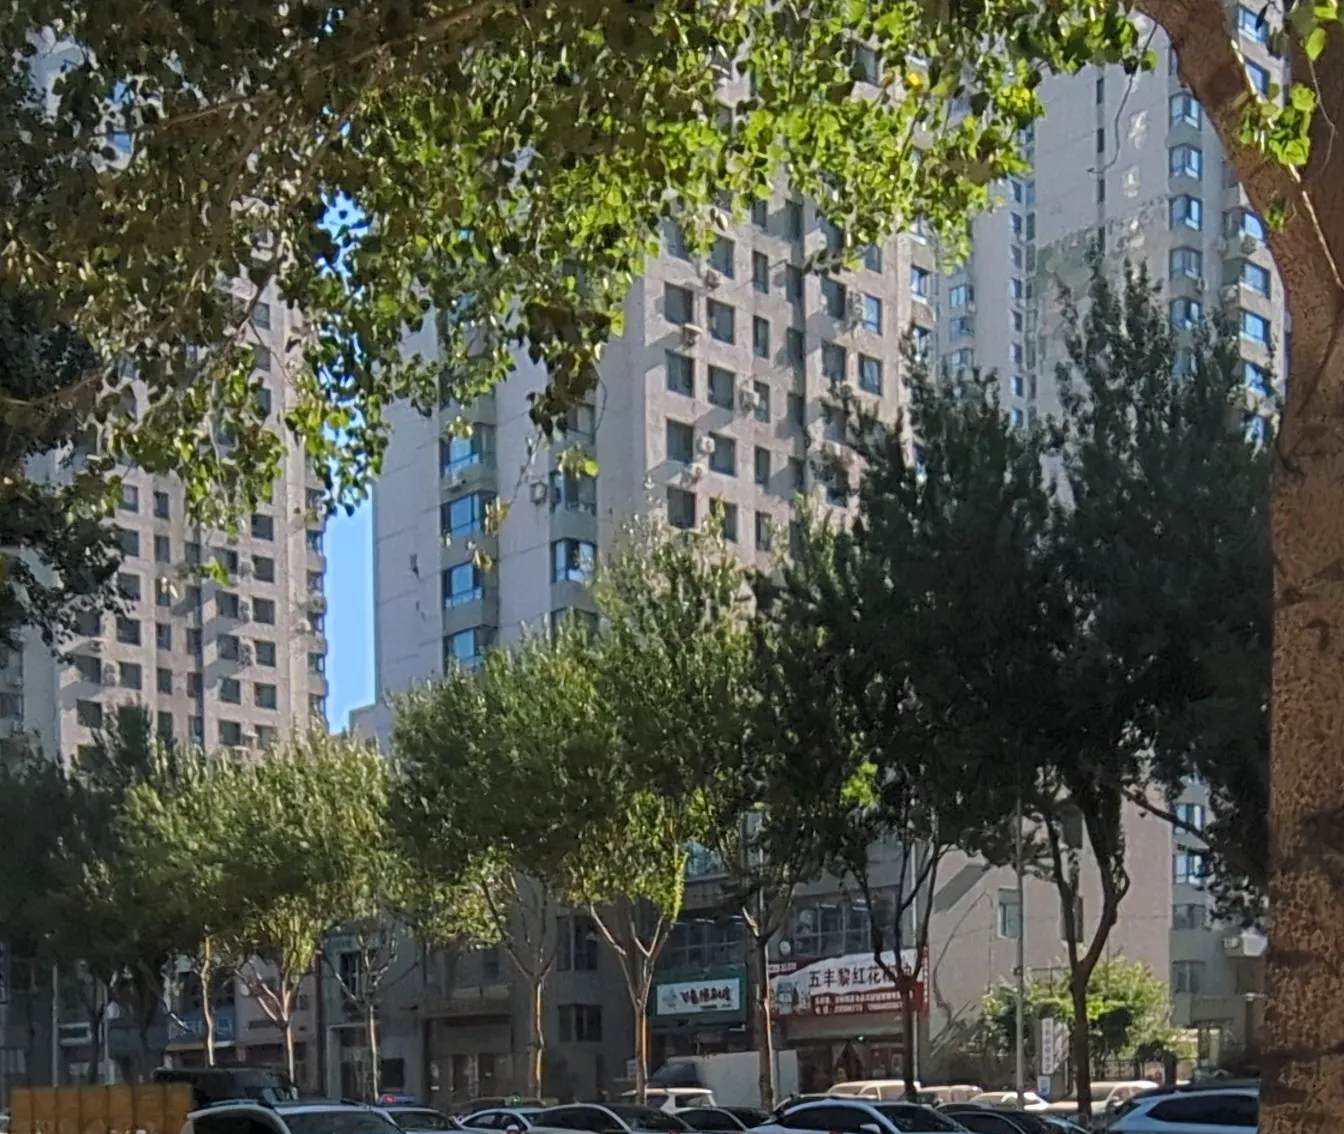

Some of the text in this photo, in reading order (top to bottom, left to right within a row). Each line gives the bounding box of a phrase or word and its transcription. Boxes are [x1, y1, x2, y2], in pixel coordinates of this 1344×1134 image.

[808, 963, 912, 988] 五丰黎红花
